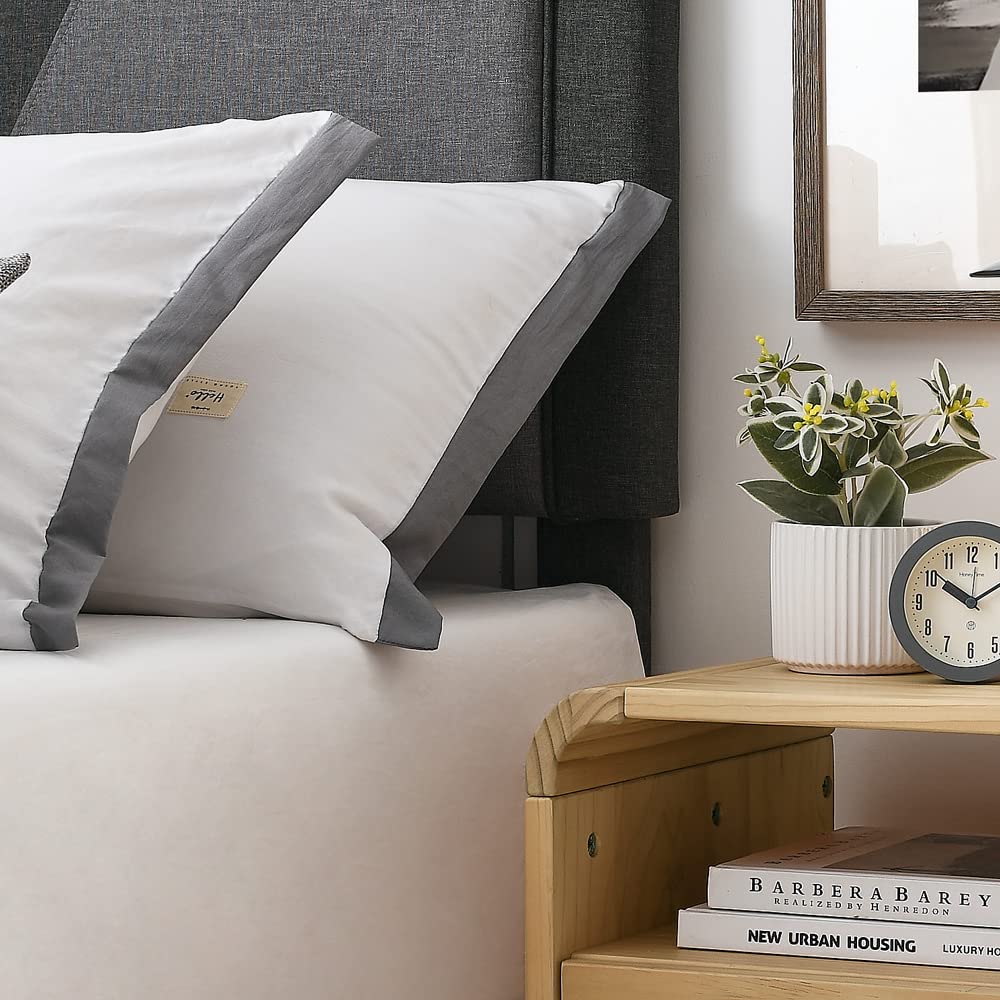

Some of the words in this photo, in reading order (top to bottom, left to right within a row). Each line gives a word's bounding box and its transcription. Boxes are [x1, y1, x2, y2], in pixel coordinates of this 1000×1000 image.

[944, 552, 954, 569] 11
[966, 546, 979, 563] 12
[994, 552, 999, 569] 1
[925, 570, 937, 587] 10
[915, 594, 922, 610] 9
[924, 619, 932, 636] 8
[944, 636, 950, 652] 7
[967, 642, 974, 659] 6
[991, 637, 998, 653] 5
[749, 877, 883, 901] BARBERA
[894, 887, 992, 907] BAREY
[774, 897, 842, 909] REALIZED
[847, 902, 863, 911] BY
[870, 902, 950, 916] HENREDON
[747, 929, 782, 944] NEW
[788, 932, 841, 948] URBAN
[847, 936, 917, 953] HOUSING
[942, 944, 984, 955] LUXURY
